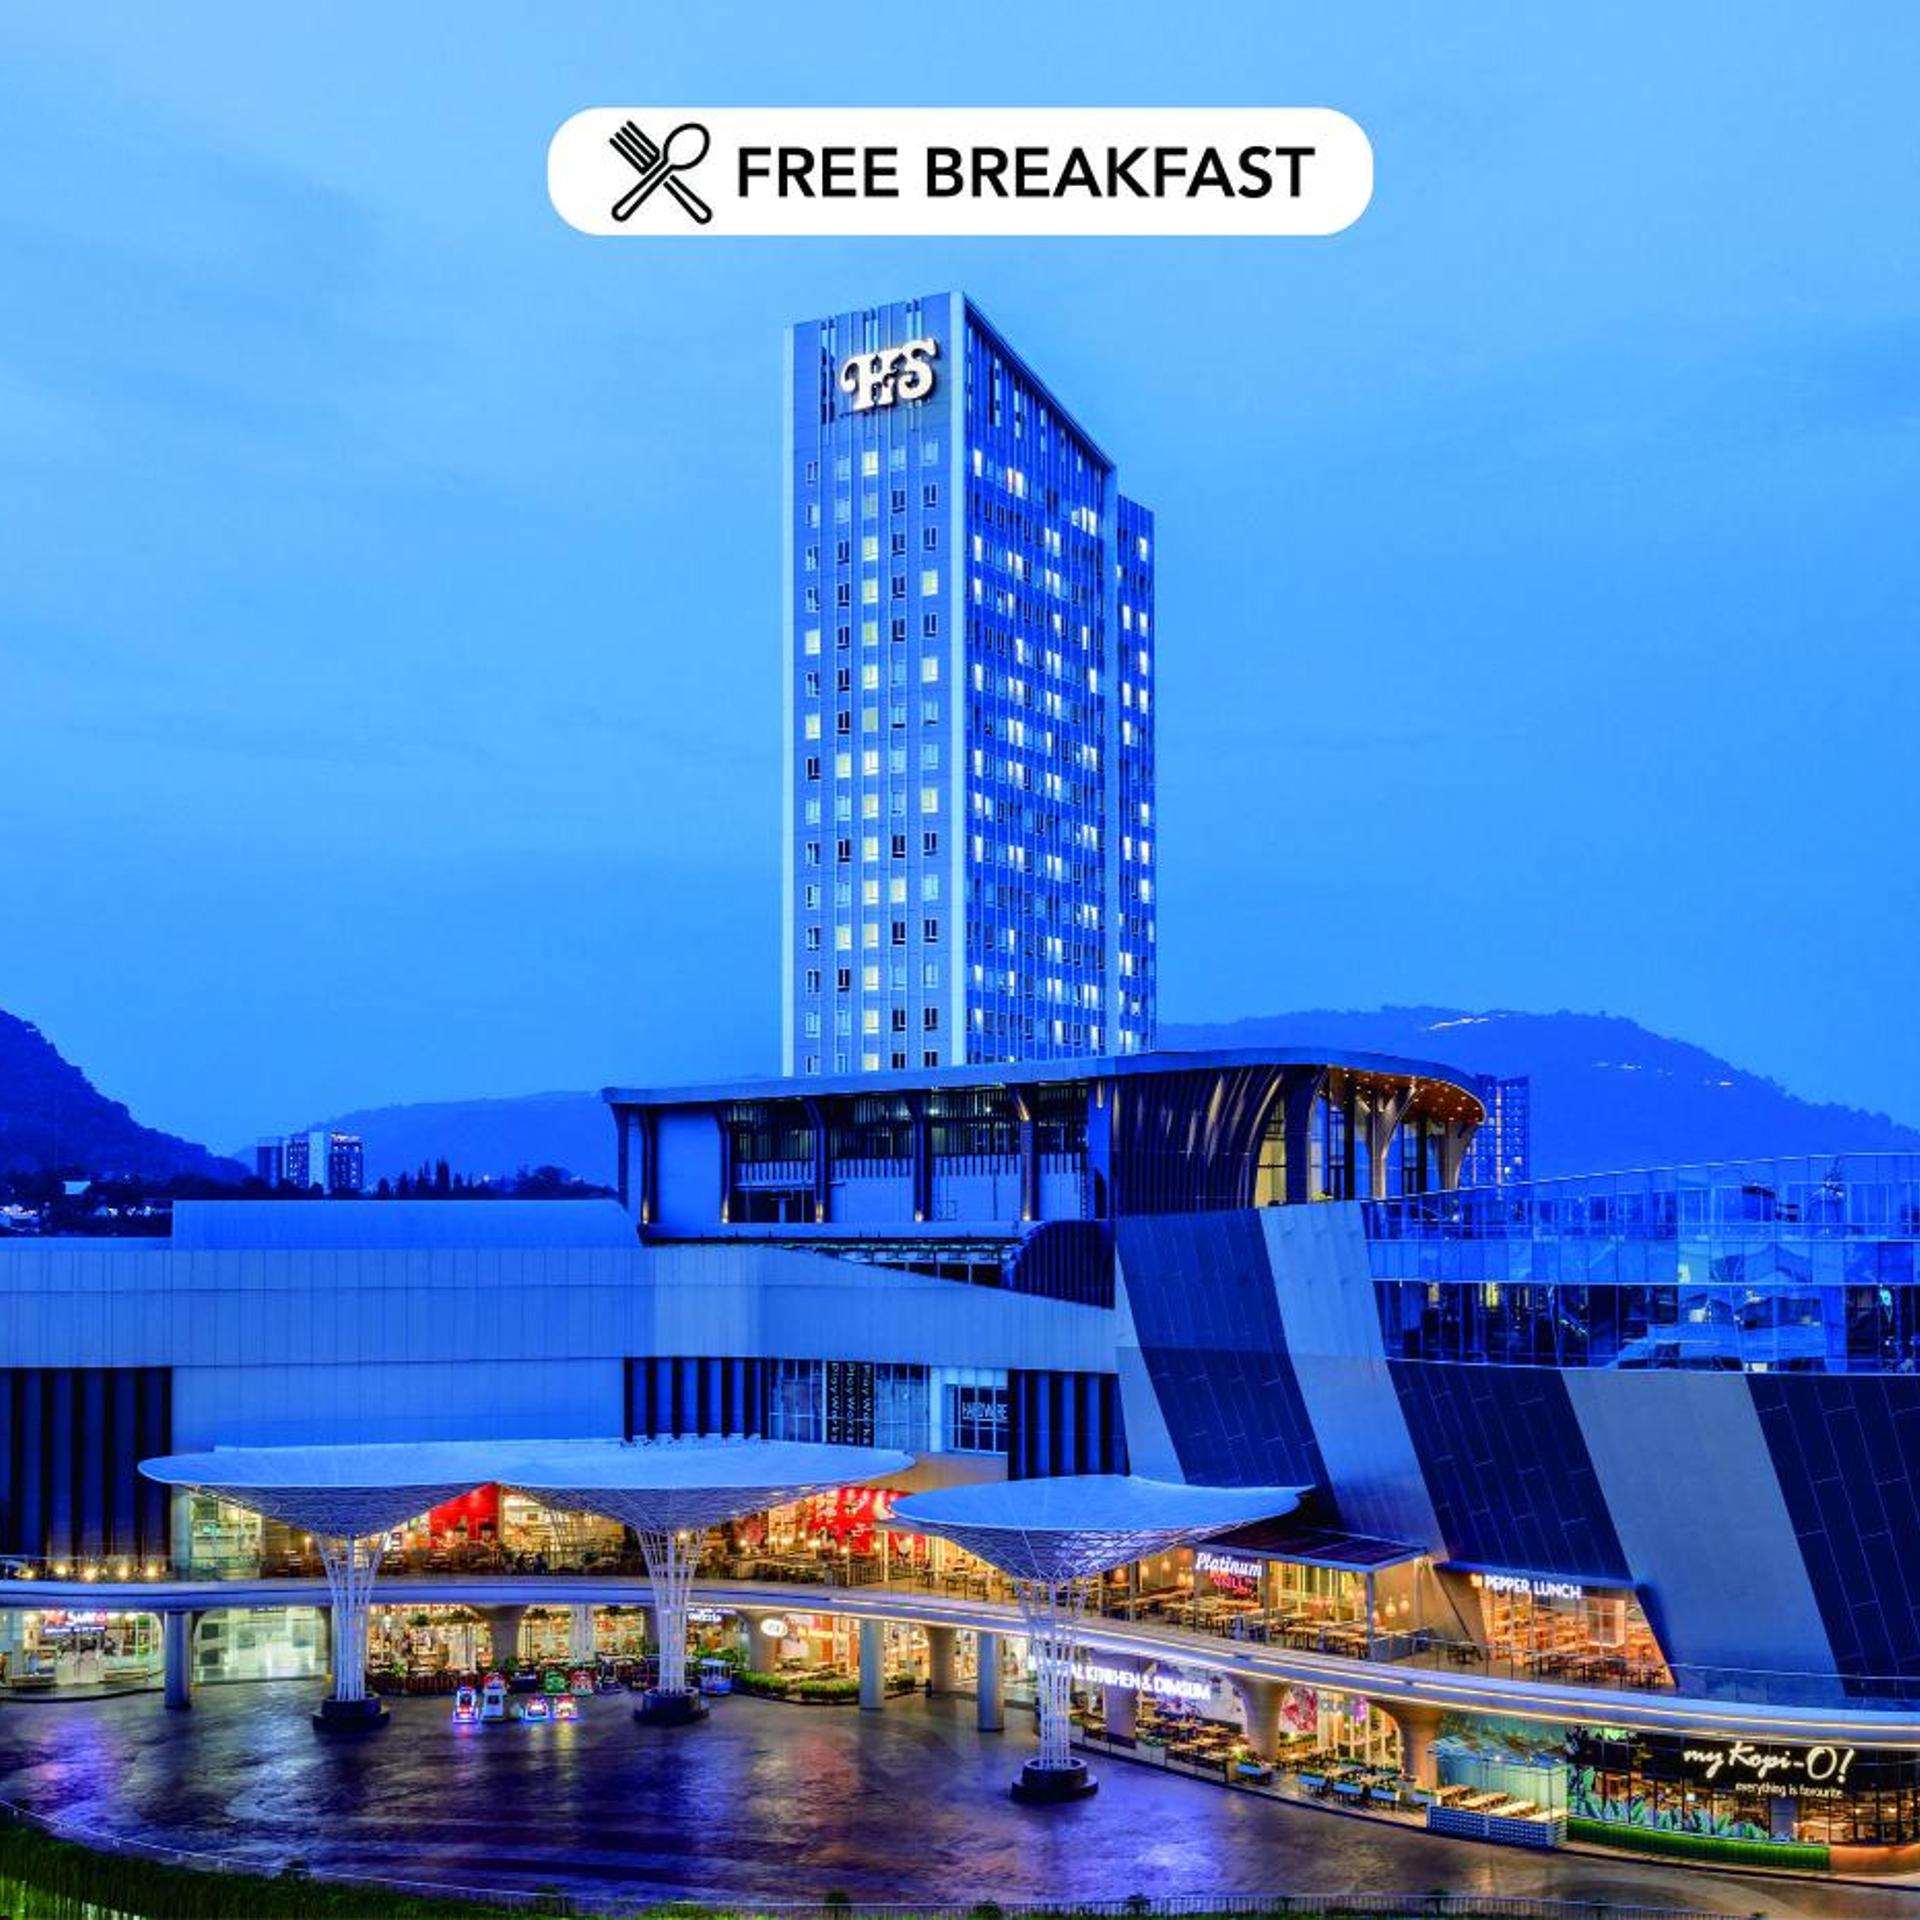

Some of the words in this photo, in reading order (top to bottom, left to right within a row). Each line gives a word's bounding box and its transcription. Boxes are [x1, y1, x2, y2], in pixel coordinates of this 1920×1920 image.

[1195, 1551, 1262, 1577] Platinum
[1484, 1574, 1531, 1594] PEPPER
[1533, 1580, 1582, 1600] LUNCH
[1682, 1749, 1725, 1779] my
[1727, 1739, 1856, 1784] Kopi-O!
[1735, 1782, 1787, 1798] everything
[1788, 1784, 1798, 1797] is
